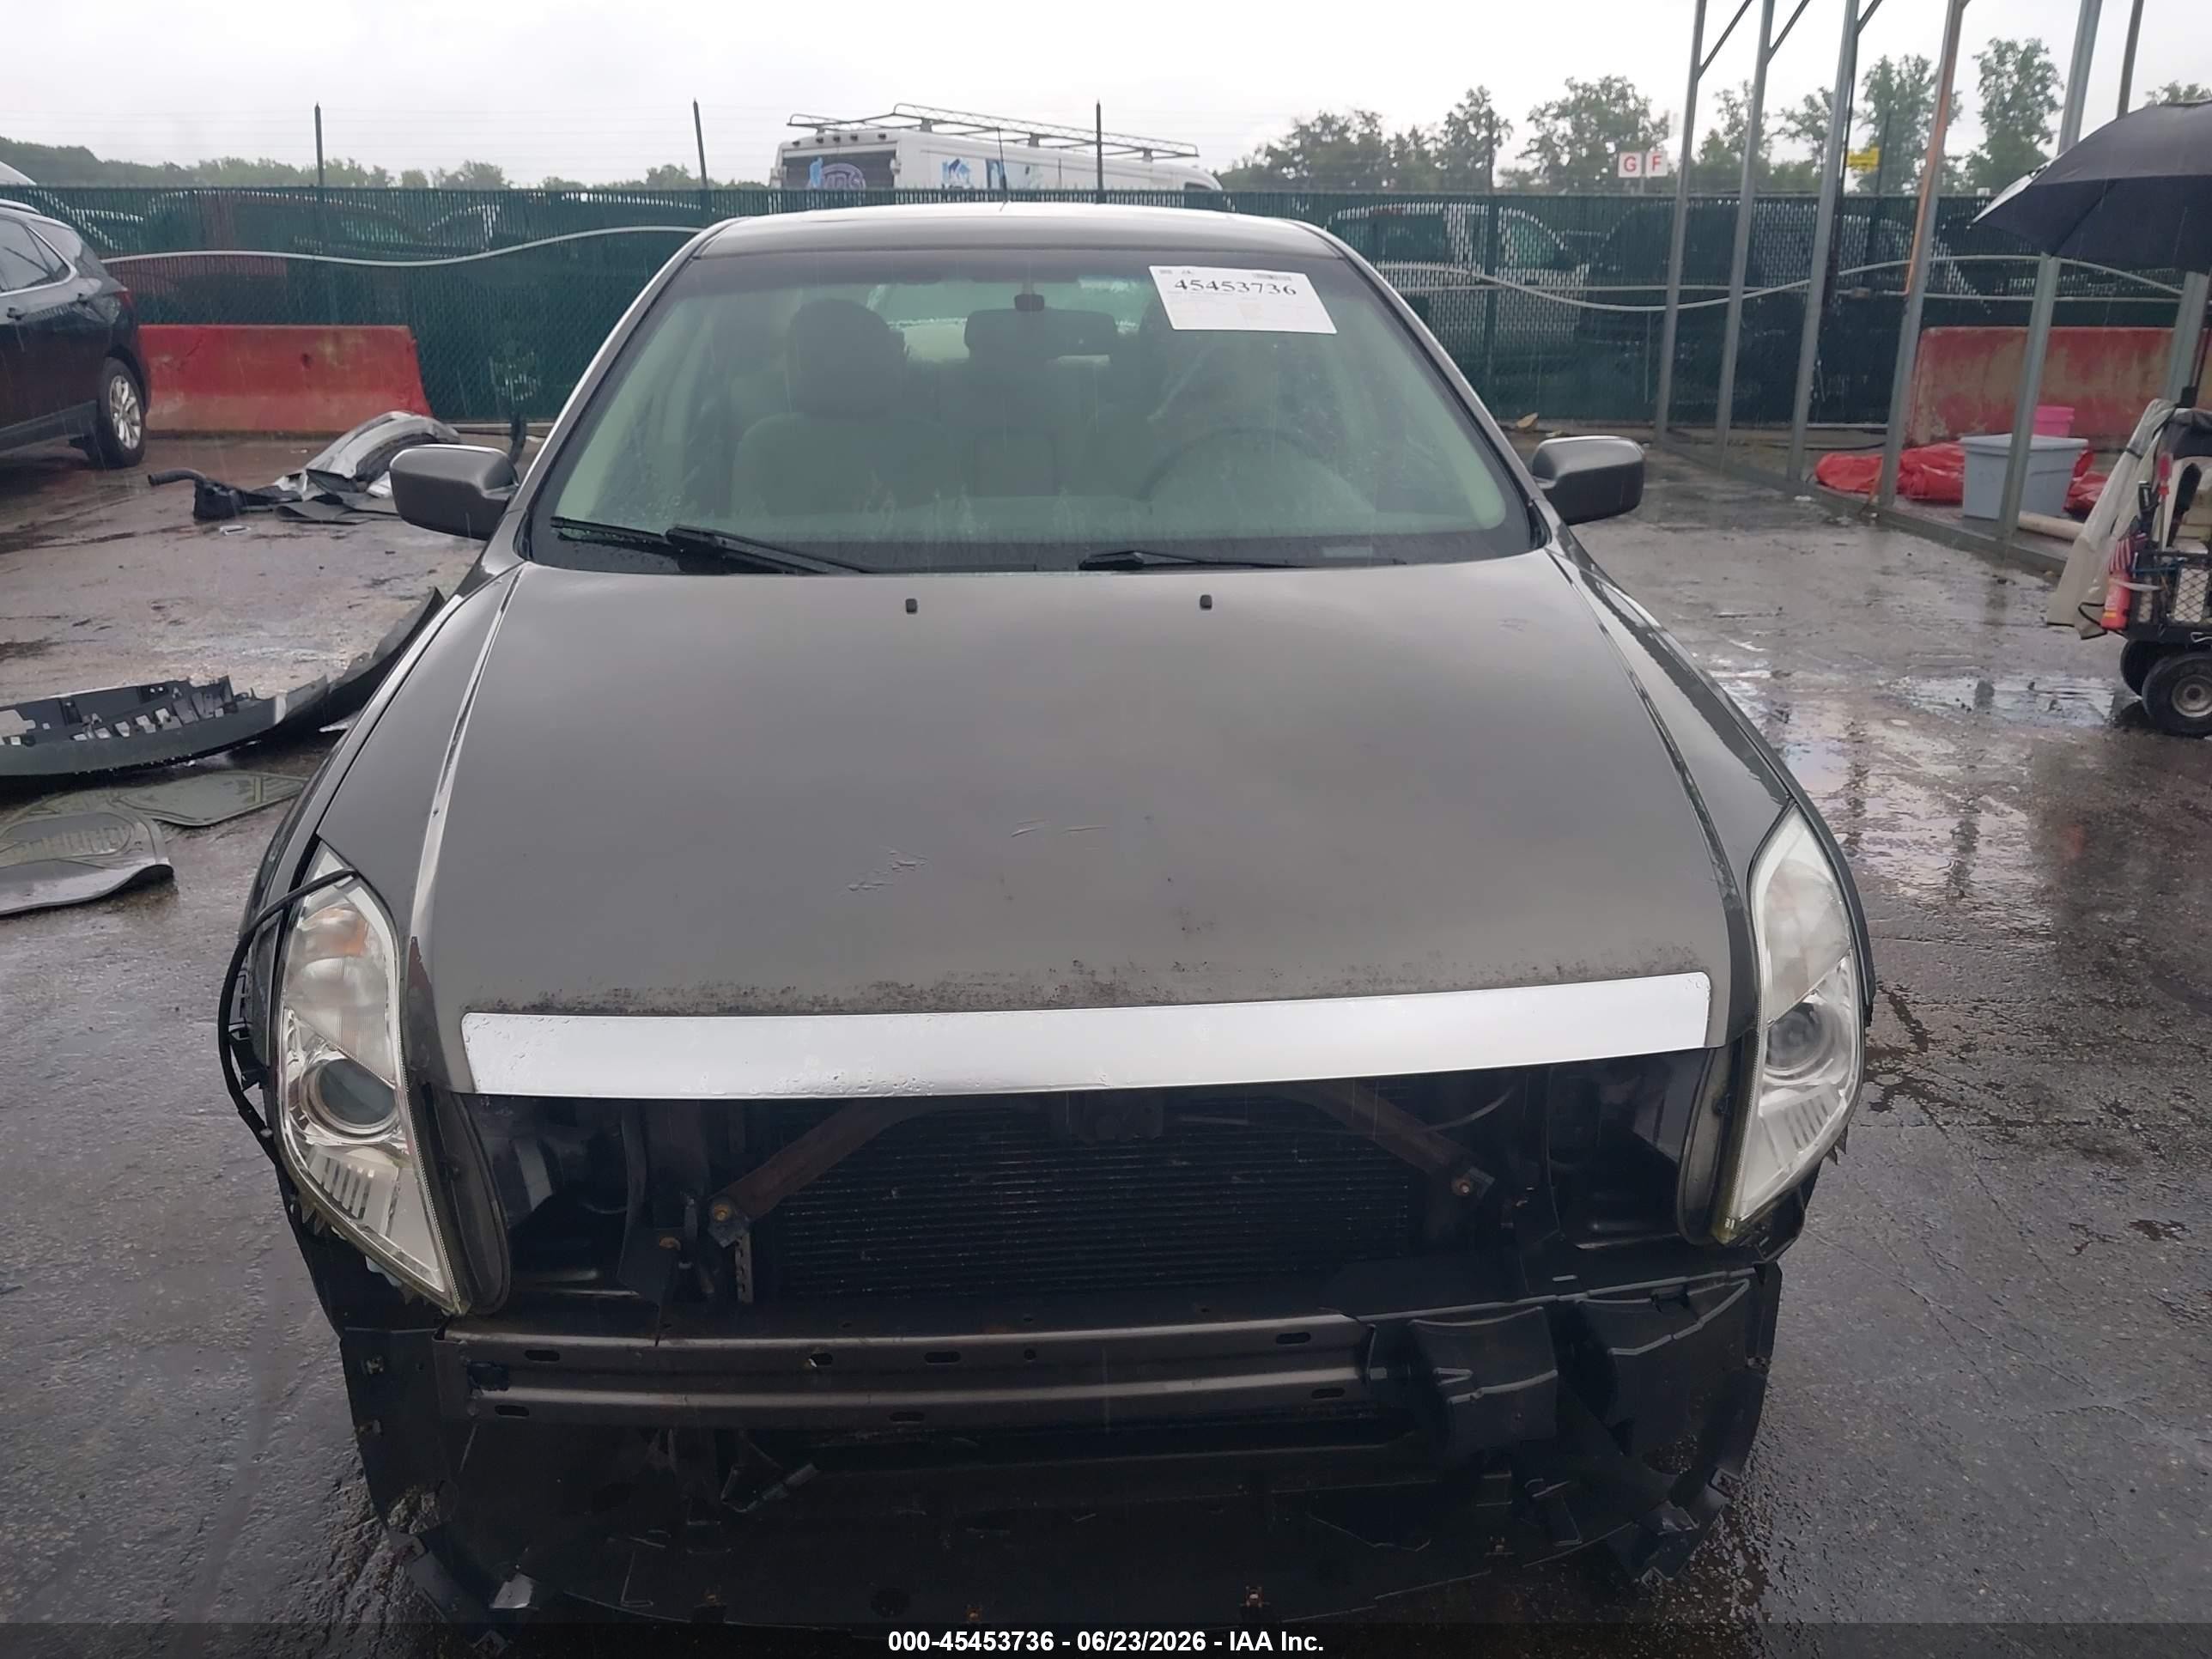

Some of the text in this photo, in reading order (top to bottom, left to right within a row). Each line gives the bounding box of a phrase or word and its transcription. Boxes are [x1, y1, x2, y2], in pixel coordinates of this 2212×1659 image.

[1624, 155, 1637, 172] G
[1652, 155, 1662, 172] F
[1175, 279, 1297, 295] 45453736
